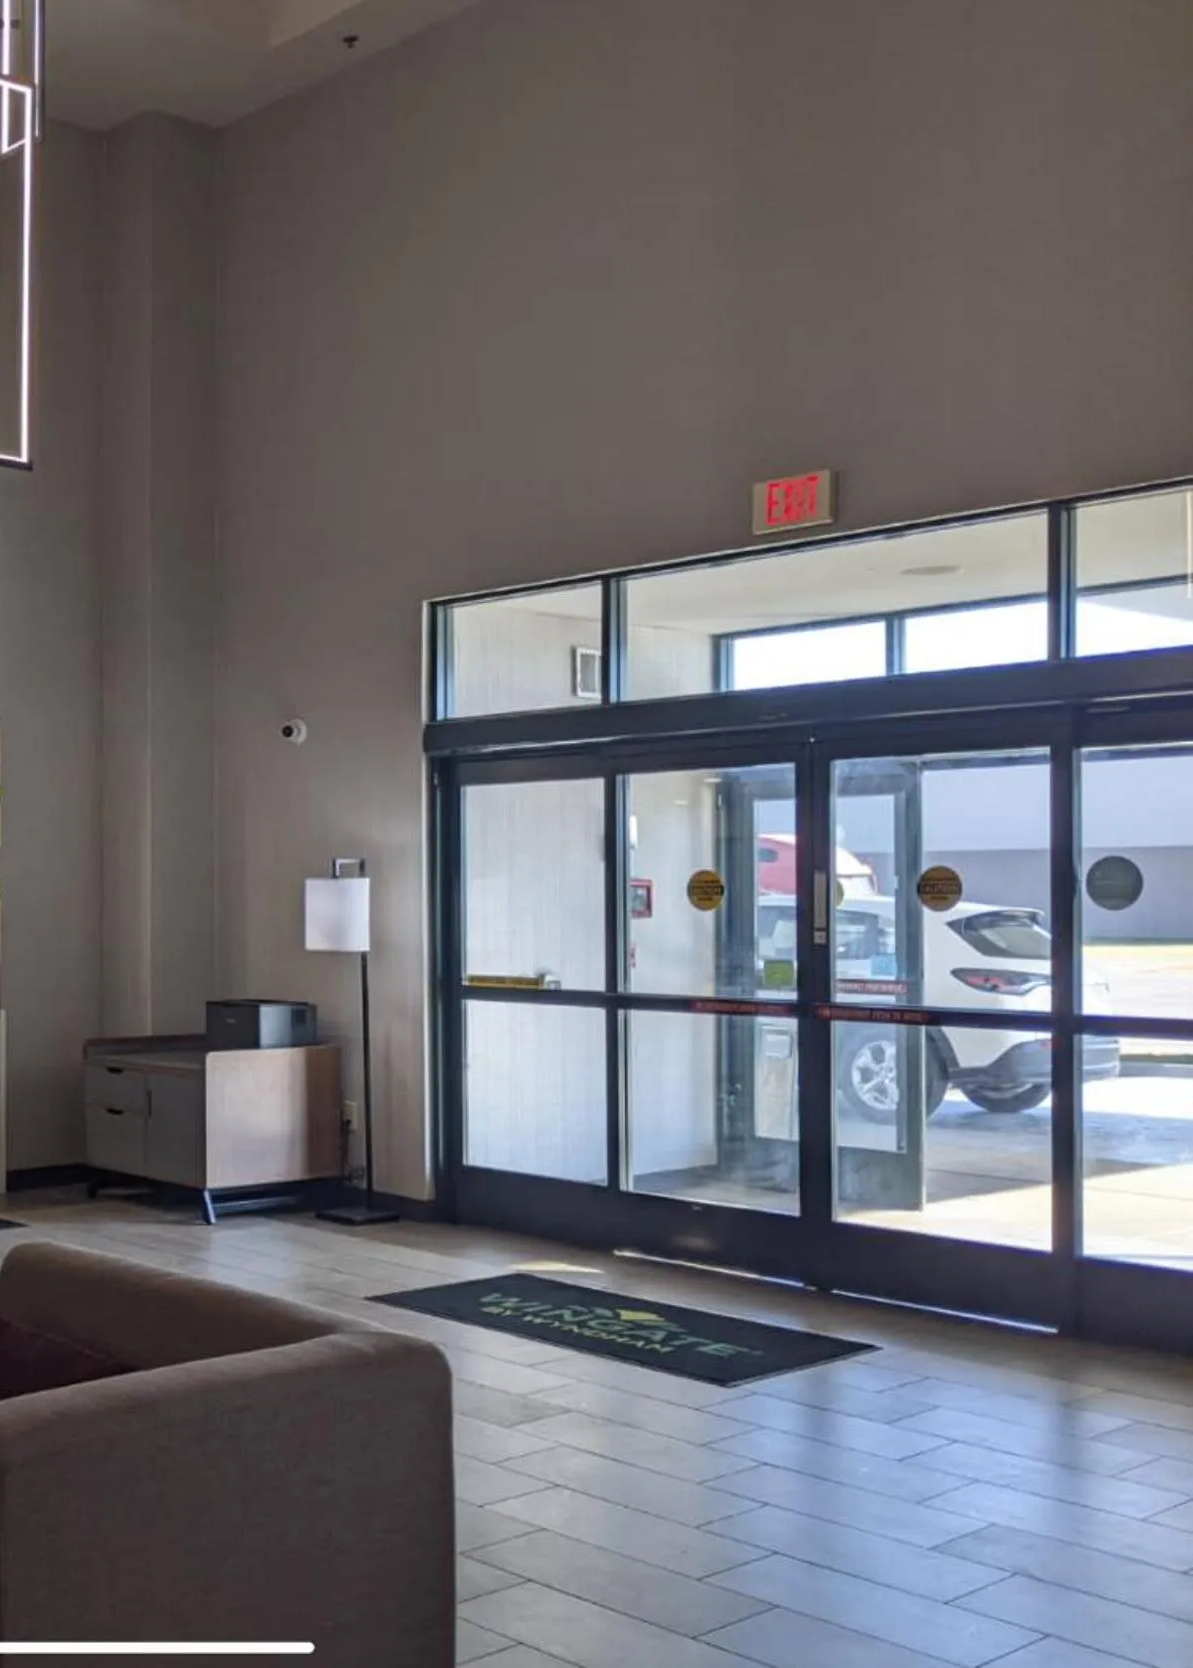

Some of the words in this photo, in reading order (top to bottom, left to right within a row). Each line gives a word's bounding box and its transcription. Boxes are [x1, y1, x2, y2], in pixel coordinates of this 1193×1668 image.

[766, 475, 819, 526] EXIT
[480, 1292, 752, 1357] WINGATE
[523, 1315, 674, 1354] WYNDHAM
